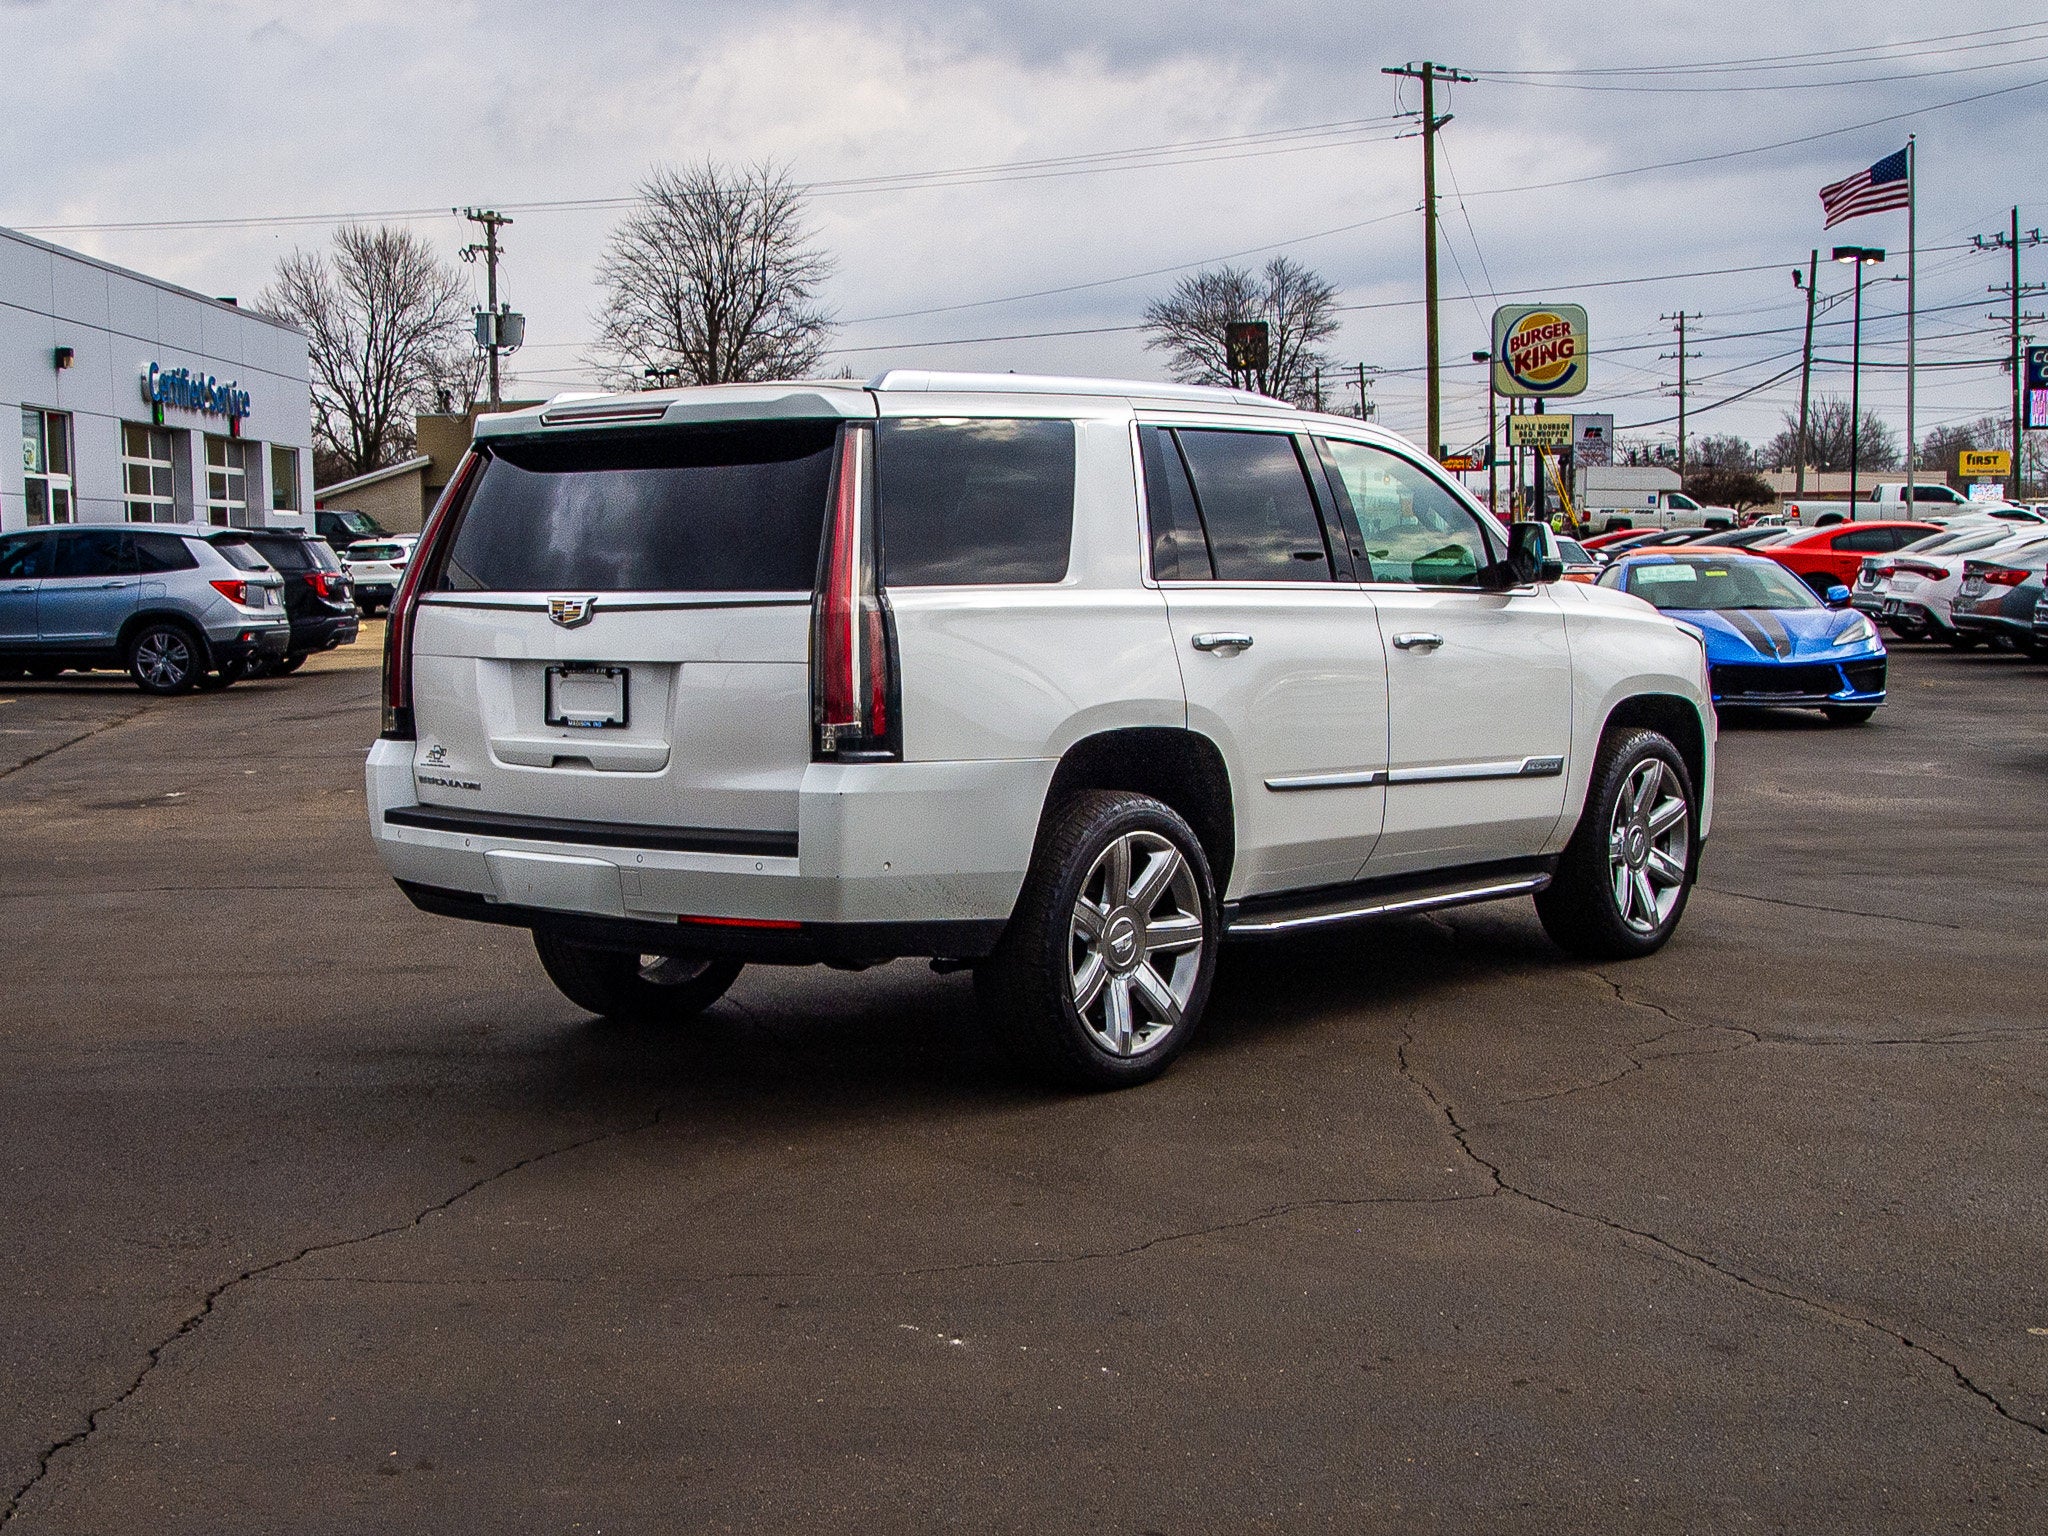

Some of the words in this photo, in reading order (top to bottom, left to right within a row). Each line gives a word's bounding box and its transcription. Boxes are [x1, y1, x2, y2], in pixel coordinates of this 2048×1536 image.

[1510, 321, 1571, 354] BURGER
[1514, 338, 1575, 375] KING
[148, 361, 205, 409] Certified
[207, 375, 251, 418] Service
[1514, 423, 1536, 431] MAPLE
[1538, 423, 1570, 431] BOURBON
